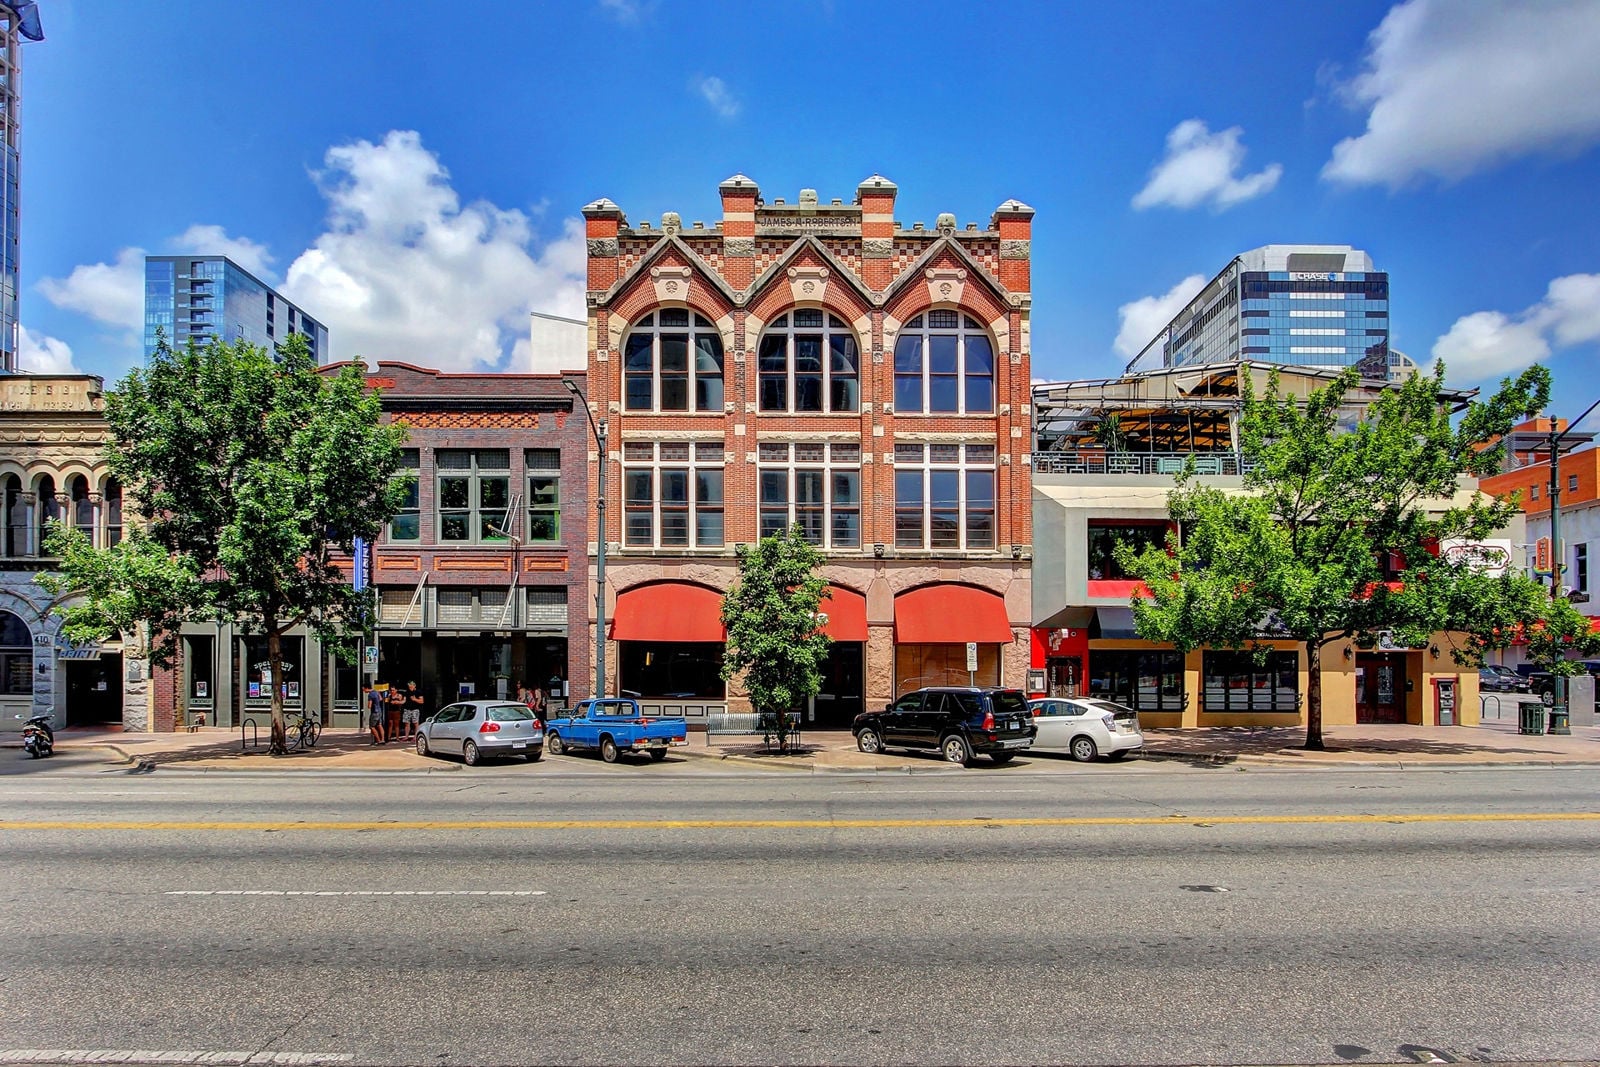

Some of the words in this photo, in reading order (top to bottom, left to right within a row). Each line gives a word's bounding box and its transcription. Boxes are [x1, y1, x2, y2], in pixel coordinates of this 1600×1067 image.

[760, 217, 793, 227] JAMES
[805, 217, 857, 227] ROBERTSON
[1296, 272, 1328, 281] CHASE
[34, 635, 49, 643] 410
